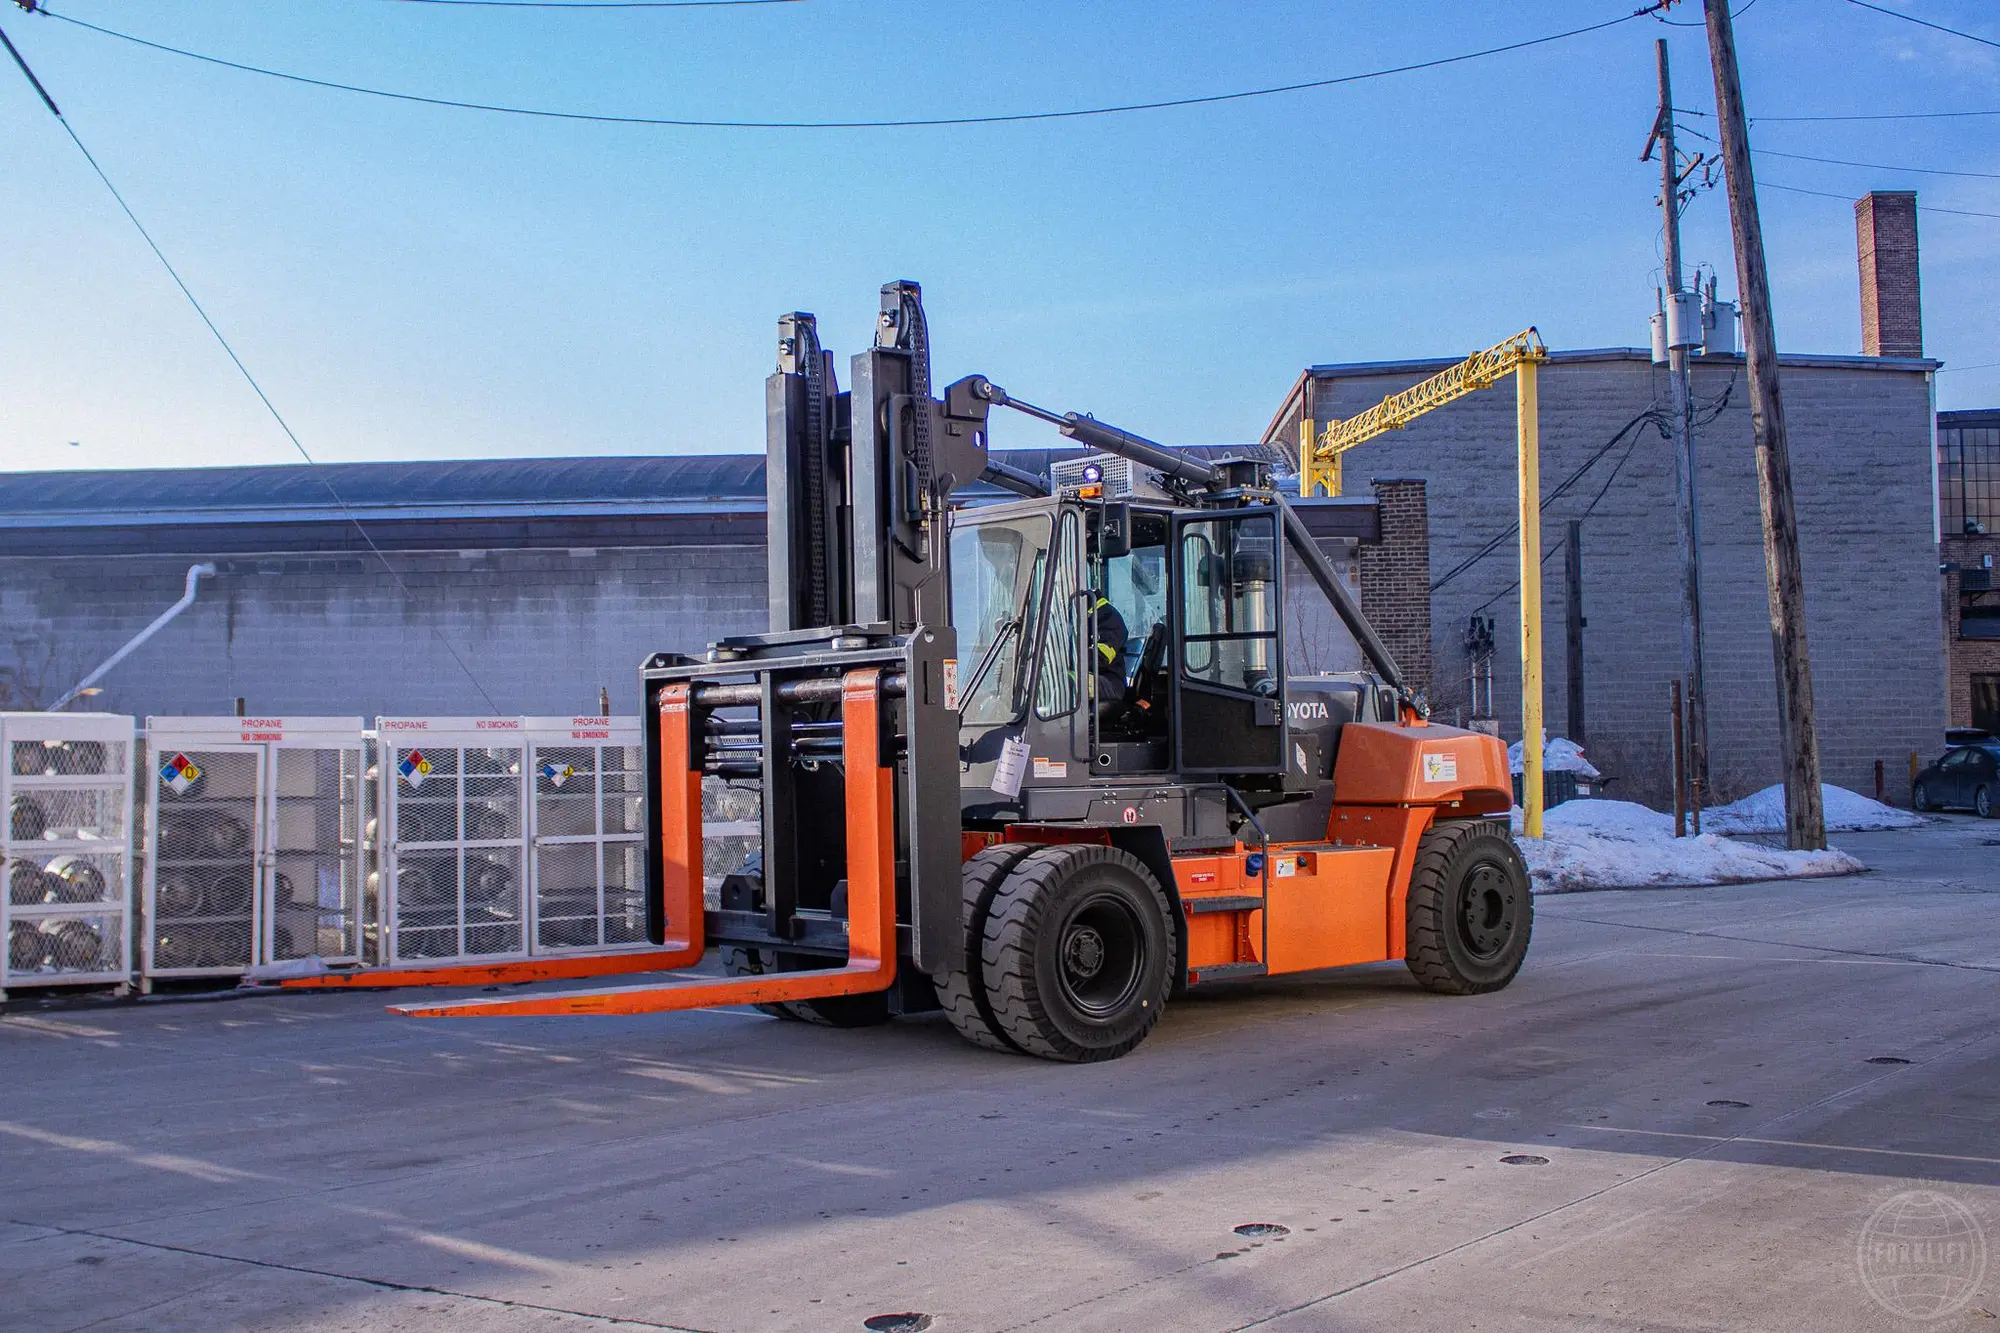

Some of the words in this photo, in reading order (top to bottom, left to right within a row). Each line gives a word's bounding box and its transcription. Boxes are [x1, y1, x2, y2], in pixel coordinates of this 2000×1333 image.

[1287, 702, 1329, 720] YOTA
[241, 719, 282, 728] PROPANE
[384, 721, 428, 730] PROPANE
[476, 720, 485, 729] NO
[487, 720, 518, 729] SMOKING
[572, 718, 609, 726] PROPANE
